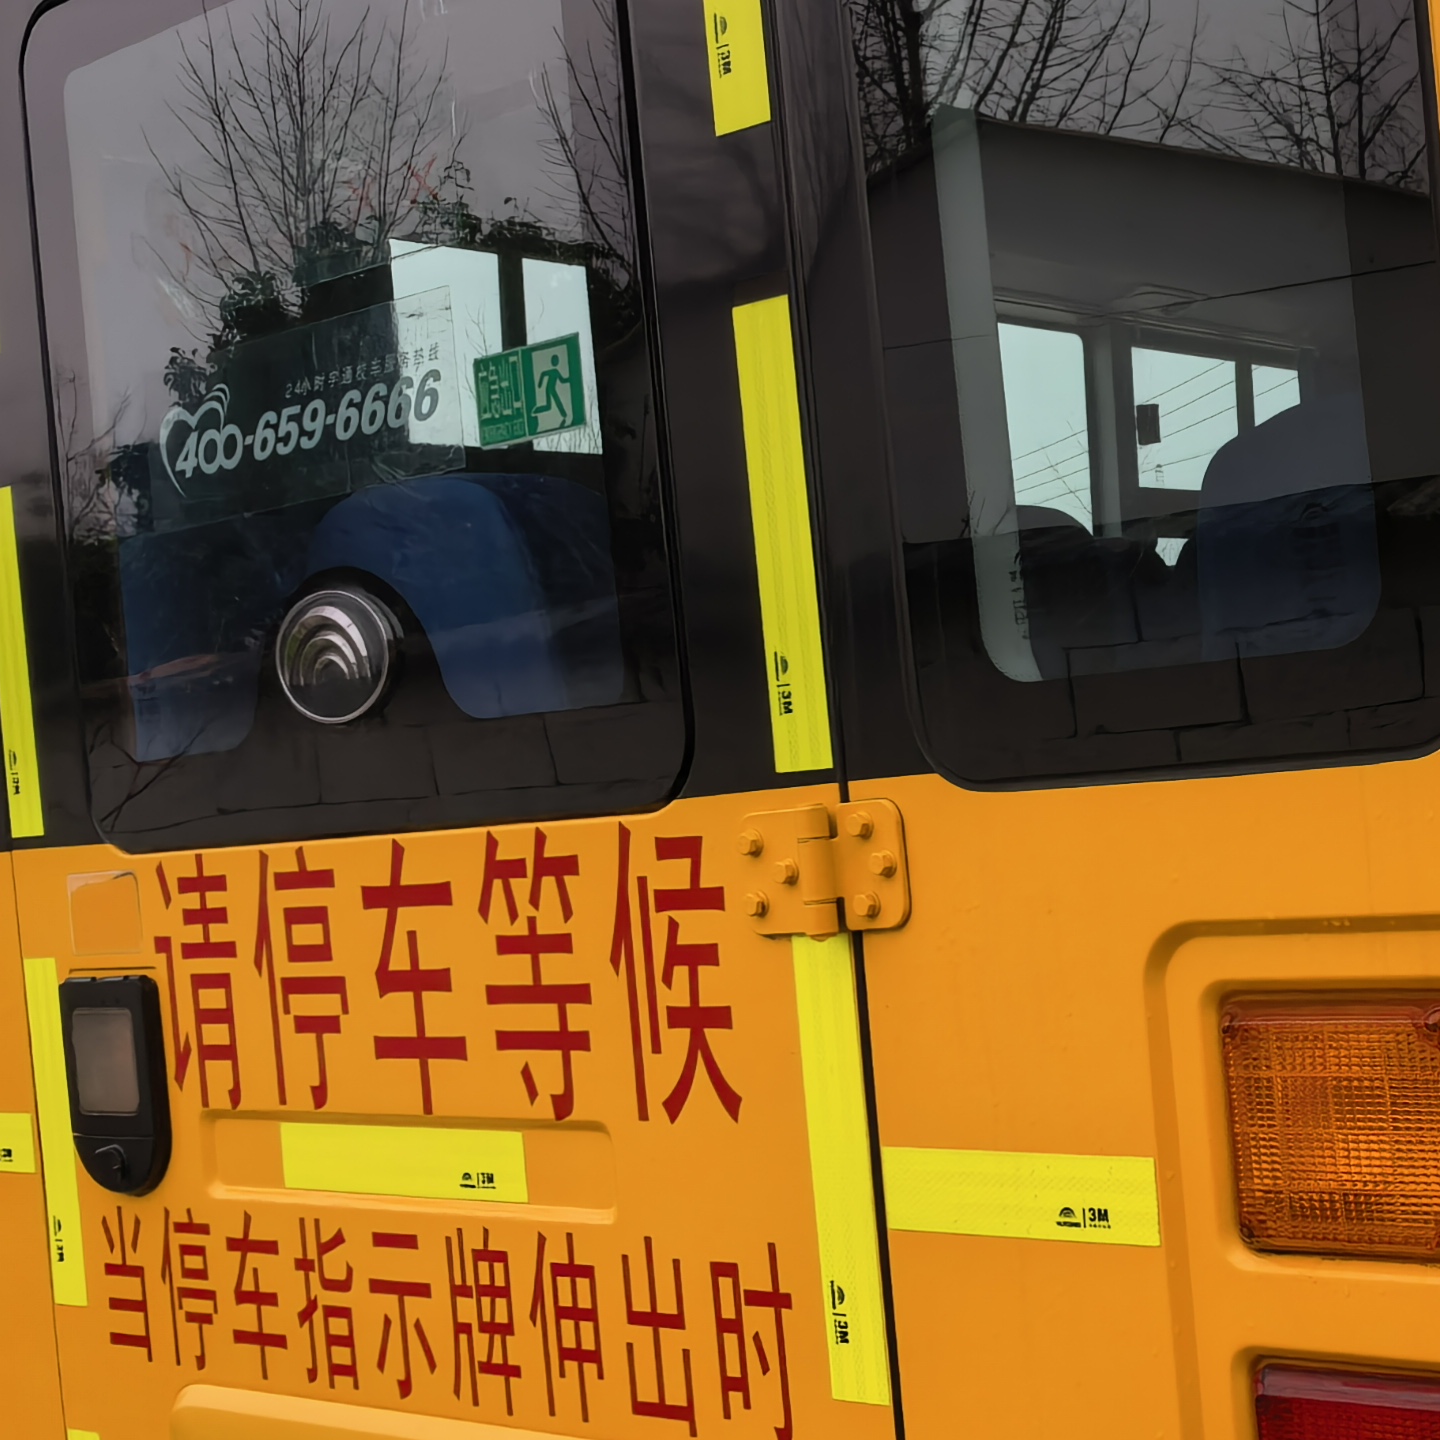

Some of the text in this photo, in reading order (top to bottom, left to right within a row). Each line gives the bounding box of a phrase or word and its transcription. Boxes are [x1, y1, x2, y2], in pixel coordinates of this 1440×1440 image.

[175, 369, 442, 479] 400-659-6666
[477, 355, 524, 421] 应急出口
[153, 820, 744, 1126] 请停车等候
[1087, 1206, 1110, 1223] 3M
